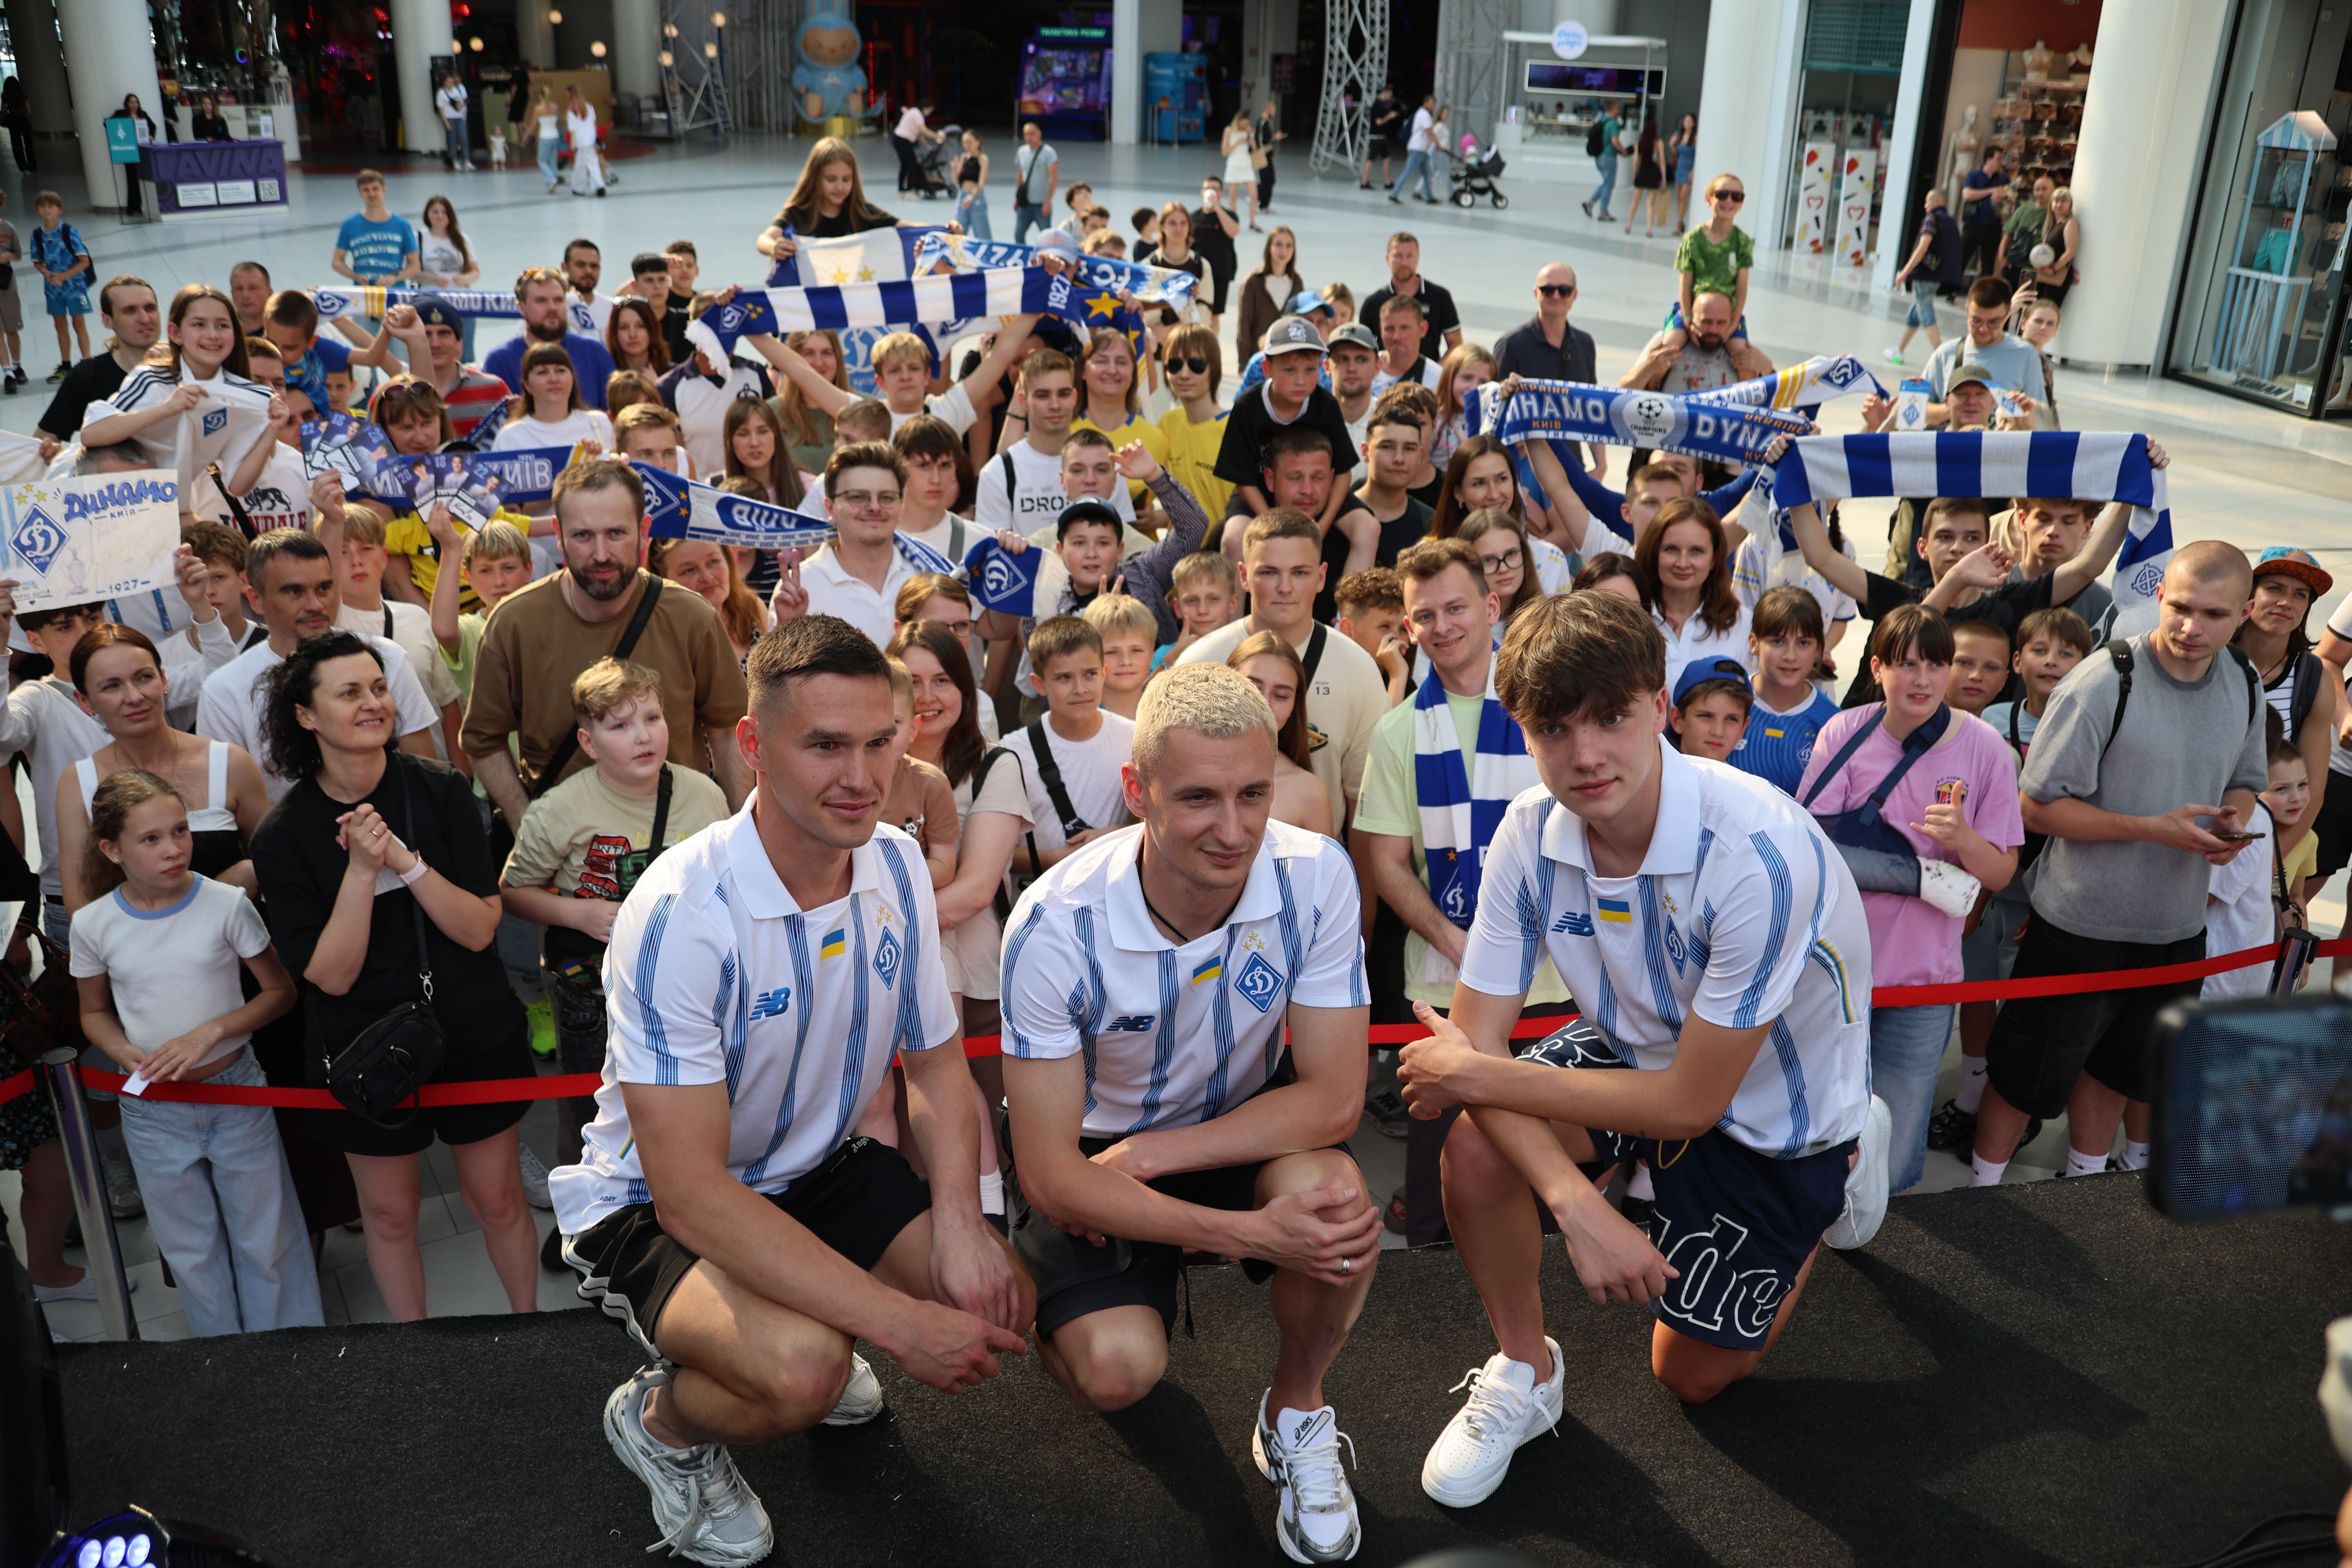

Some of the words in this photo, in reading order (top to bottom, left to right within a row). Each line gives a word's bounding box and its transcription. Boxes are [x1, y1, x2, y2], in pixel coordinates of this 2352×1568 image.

[157, 149, 279, 180] LAVINA
[1047, 274, 1072, 310] 1927
[1506, 393, 1607, 425] ИНАМО
[1694, 413, 1782, 453] DYNA
[1745, 413, 1808, 435] UKRAINE
[1583, 433, 1638, 446] VICTORY
[1661, 443, 1725, 463] TOGETHER
[435, 456, 446, 468] 18
[64, 479, 178, 523] ДИНАМО
[110, 508, 136, 519] КИЇВ
[33, 555, 50, 564] КИЇВ
[109, 579, 138, 593] 1927
[1316, 686, 1330, 695] 13
[1299, 1416, 1313, 1432] asics
